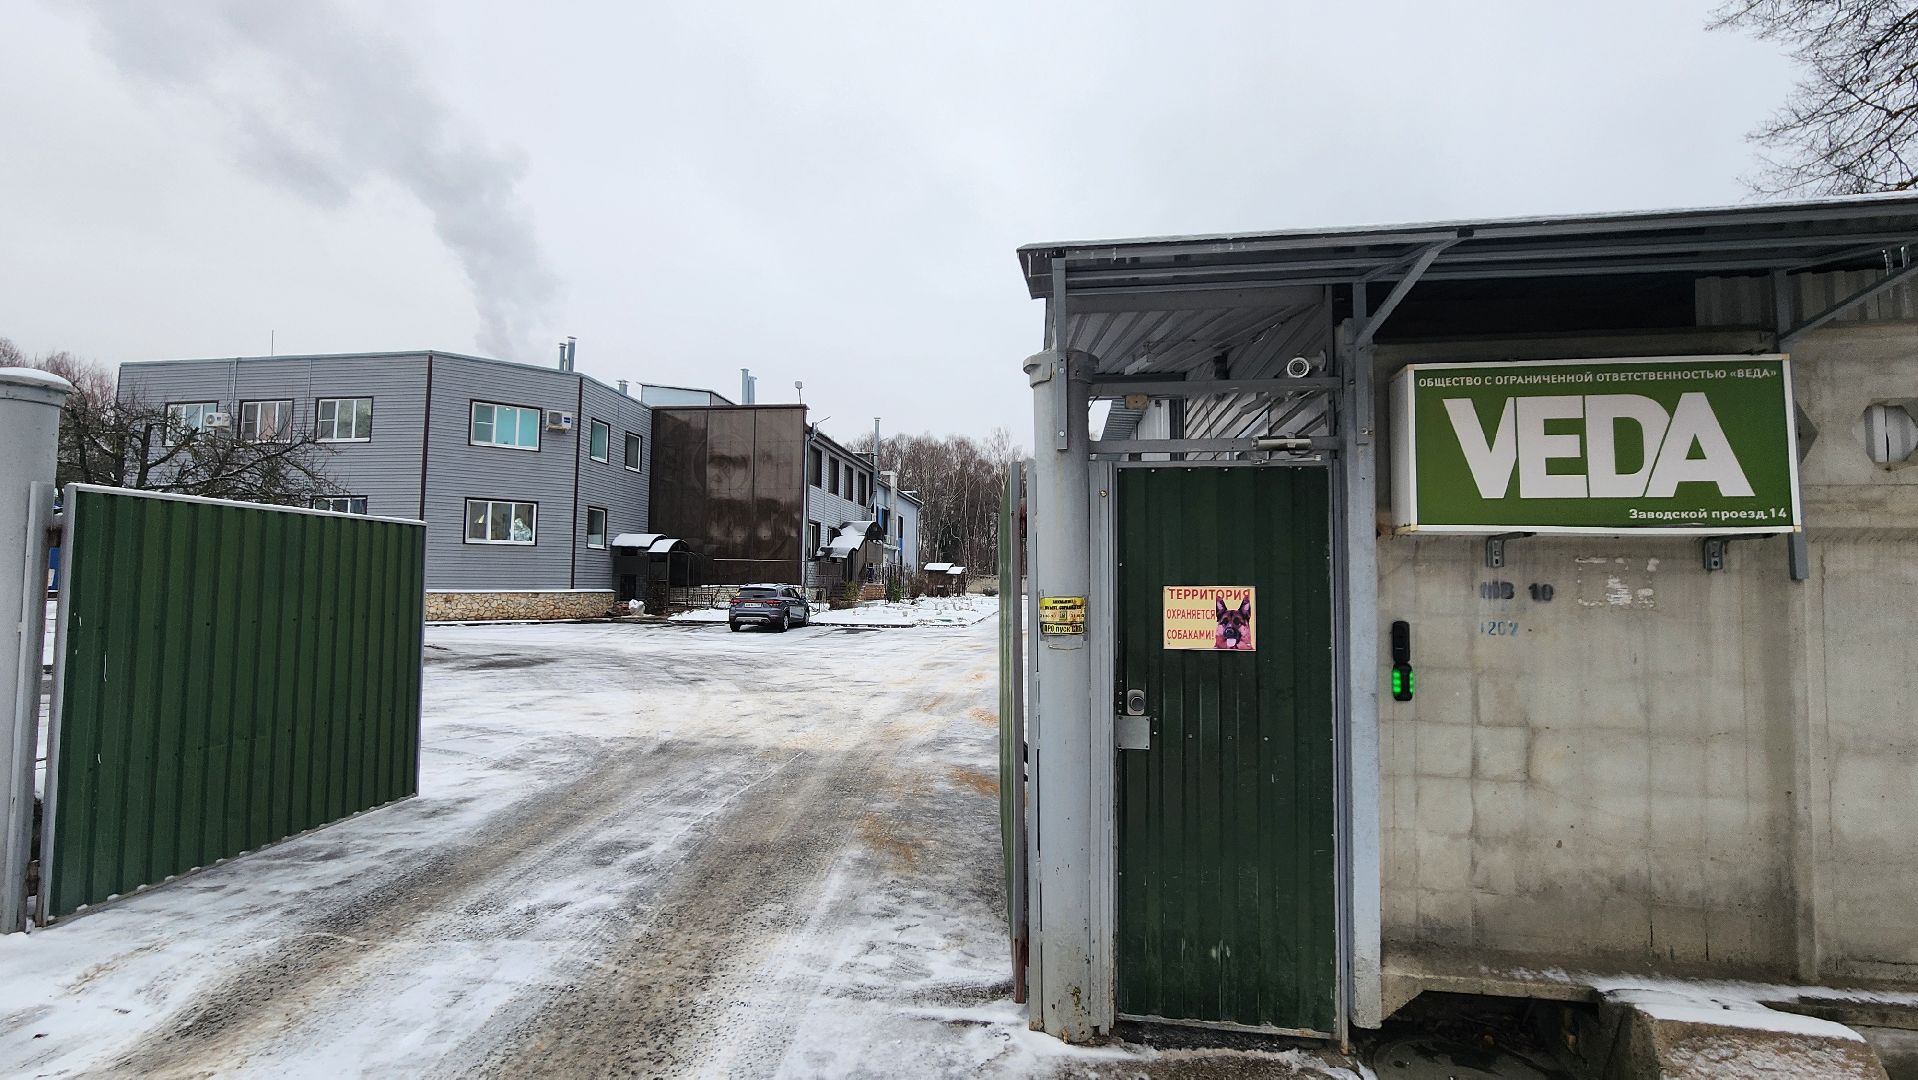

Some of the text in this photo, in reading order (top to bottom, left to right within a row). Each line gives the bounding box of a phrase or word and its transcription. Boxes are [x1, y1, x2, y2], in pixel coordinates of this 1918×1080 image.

[1418, 368, 1777, 388] ОБЩЕСТВО С ОГРАНИЧЕННОЙ ОТВЕТСТВЕННОСТЬЮ «ВЕДА»
[1442, 392, 1756, 499] VEDA
[1628, 507, 1708, 520] Заводской
[1167, 588, 1251, 601] ТЕРРИТОРИЯ
[1166, 608, 1216, 620] ОХРАНЯЕТСЯ
[1166, 629, 1215, 640] СОБАКАМИ!
